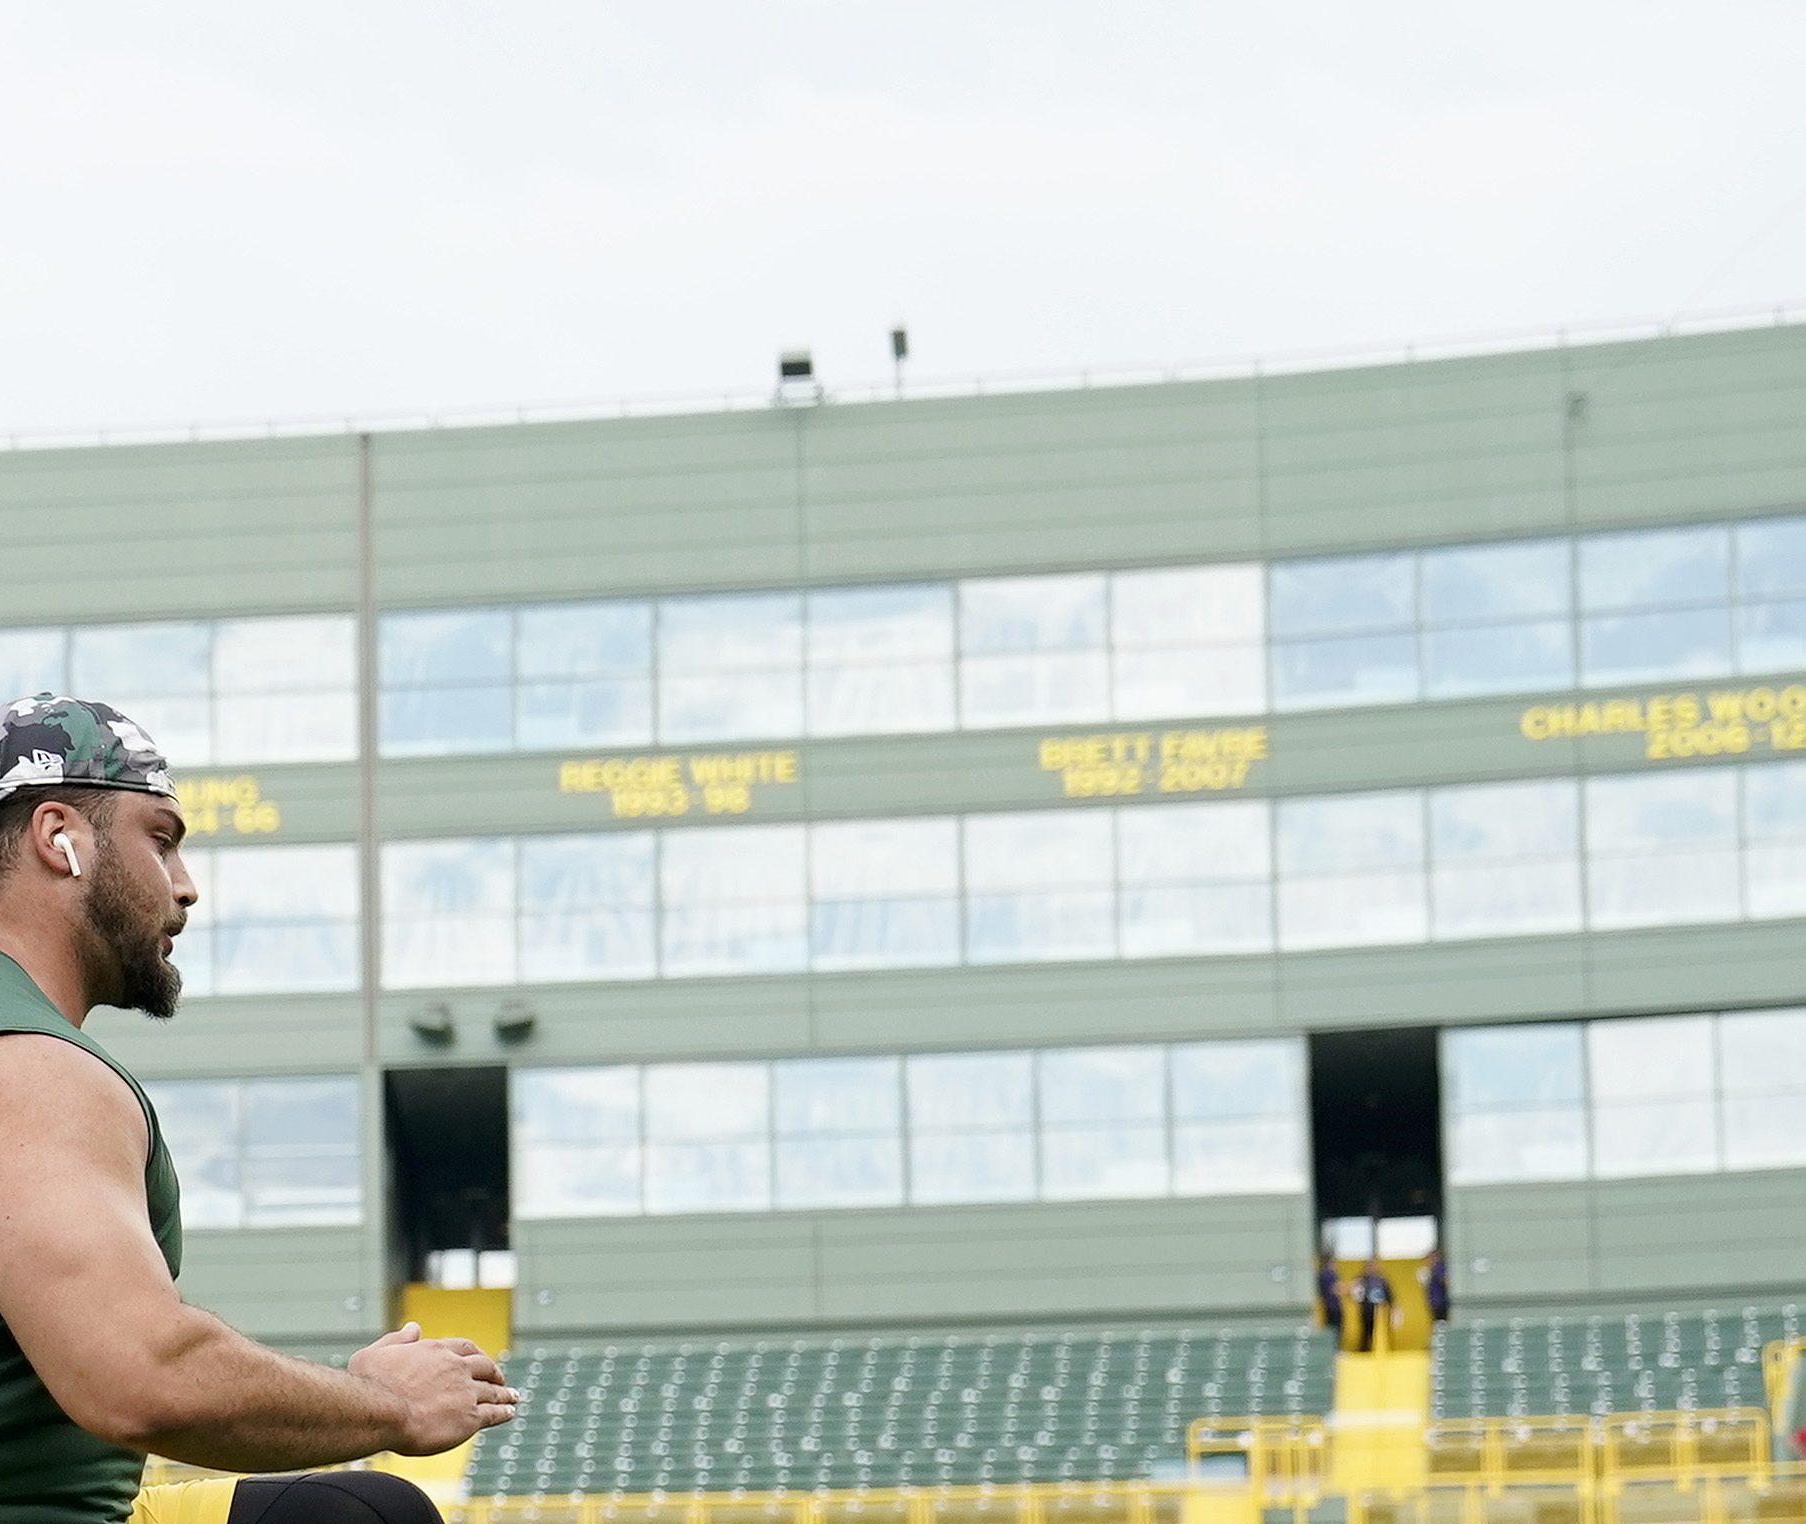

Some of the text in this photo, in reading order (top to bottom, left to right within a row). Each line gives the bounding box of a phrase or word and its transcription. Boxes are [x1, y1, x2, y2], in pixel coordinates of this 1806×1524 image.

[1520, 696, 1701, 740] CHARLES
[560, 752, 795, 793] REGGIE WHITE
[1040, 733, 1151, 771] BRETT
